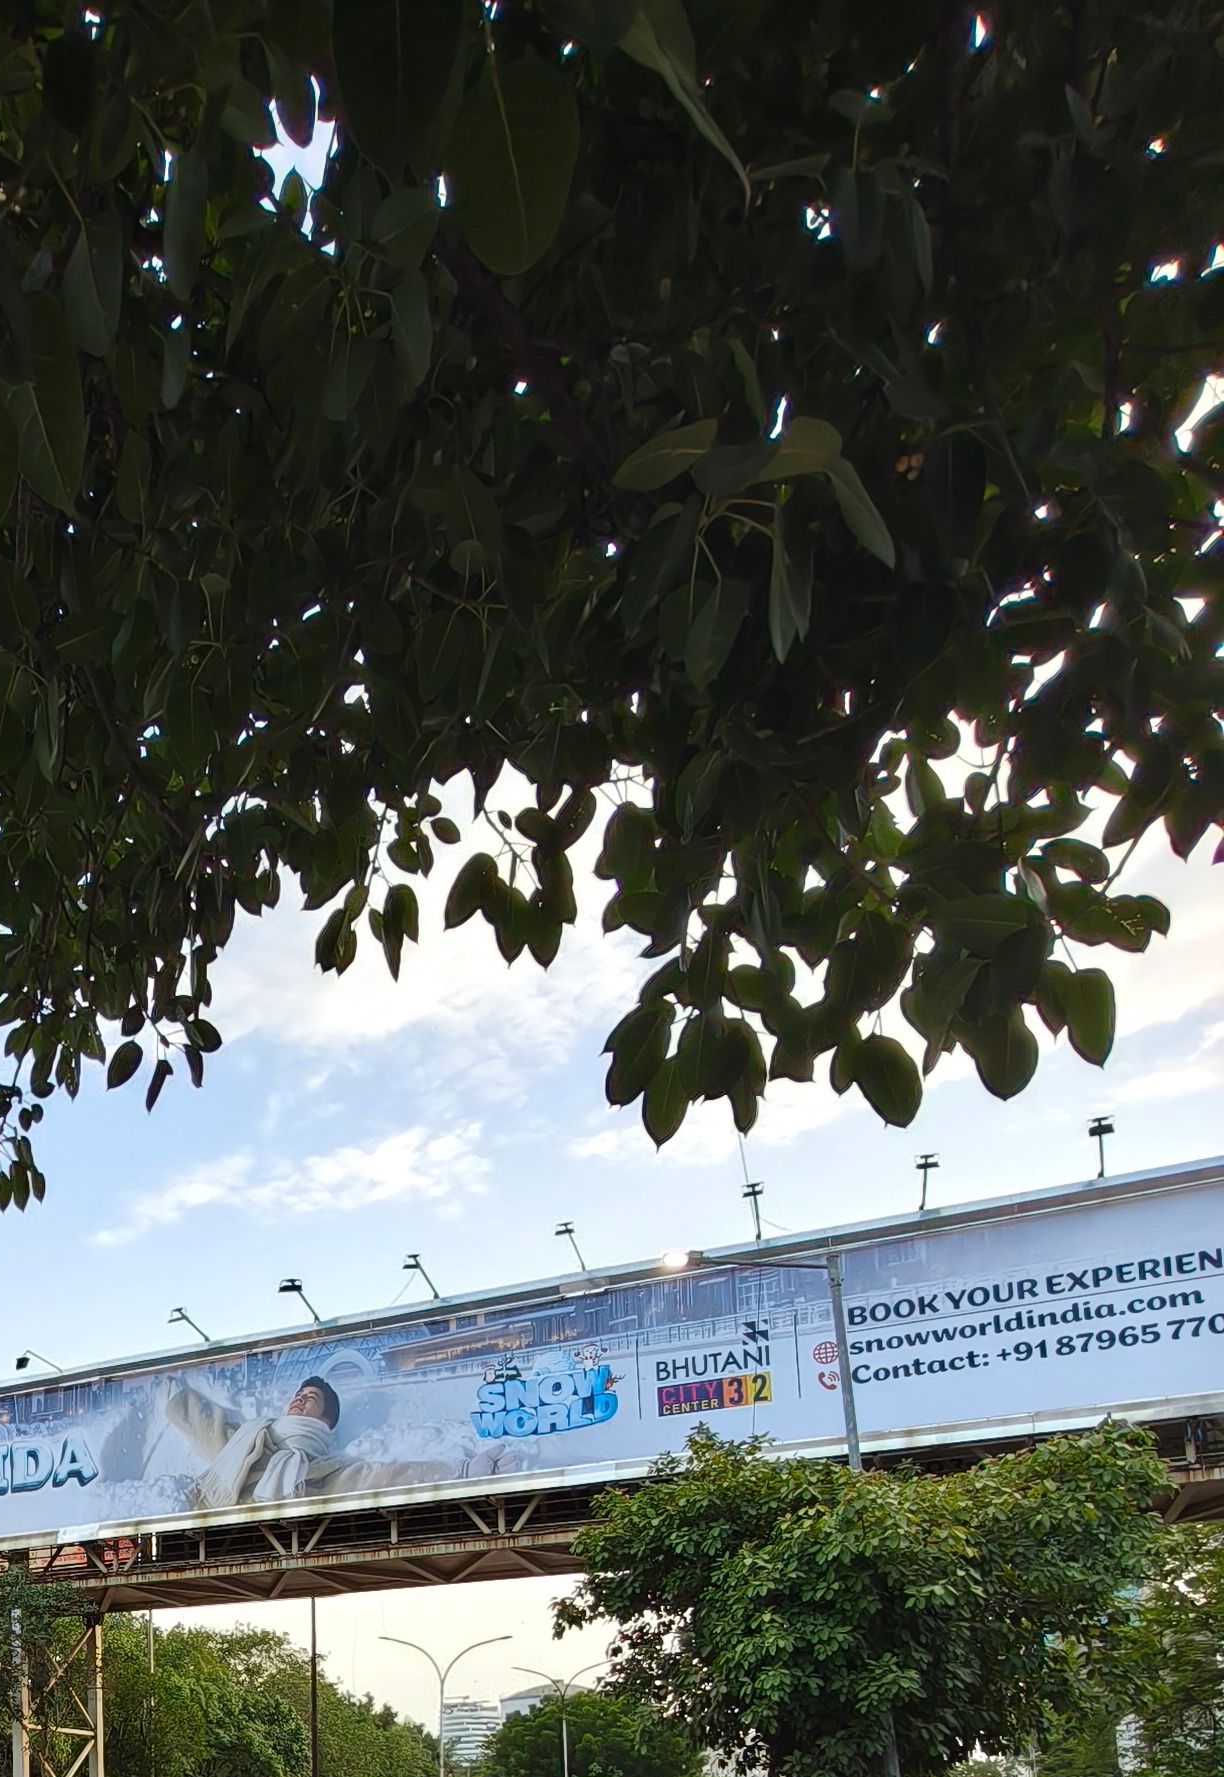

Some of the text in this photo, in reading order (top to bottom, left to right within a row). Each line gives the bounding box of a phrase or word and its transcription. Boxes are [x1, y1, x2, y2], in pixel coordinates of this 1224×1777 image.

[847, 1247, 1223, 1326] BOOK YOUR EXPERIEN
[849, 1289, 1205, 1355] snowworldindia.com
[656, 1344, 770, 1381] BHUTANI
[851, 1351, 990, 1384] Contact:
[477, 1364, 610, 1414] SNOW
[661, 1382, 722, 1405] CITY
[662, 1398, 719, 1415] CENTER
[470, 1391, 619, 1438] WORLD
